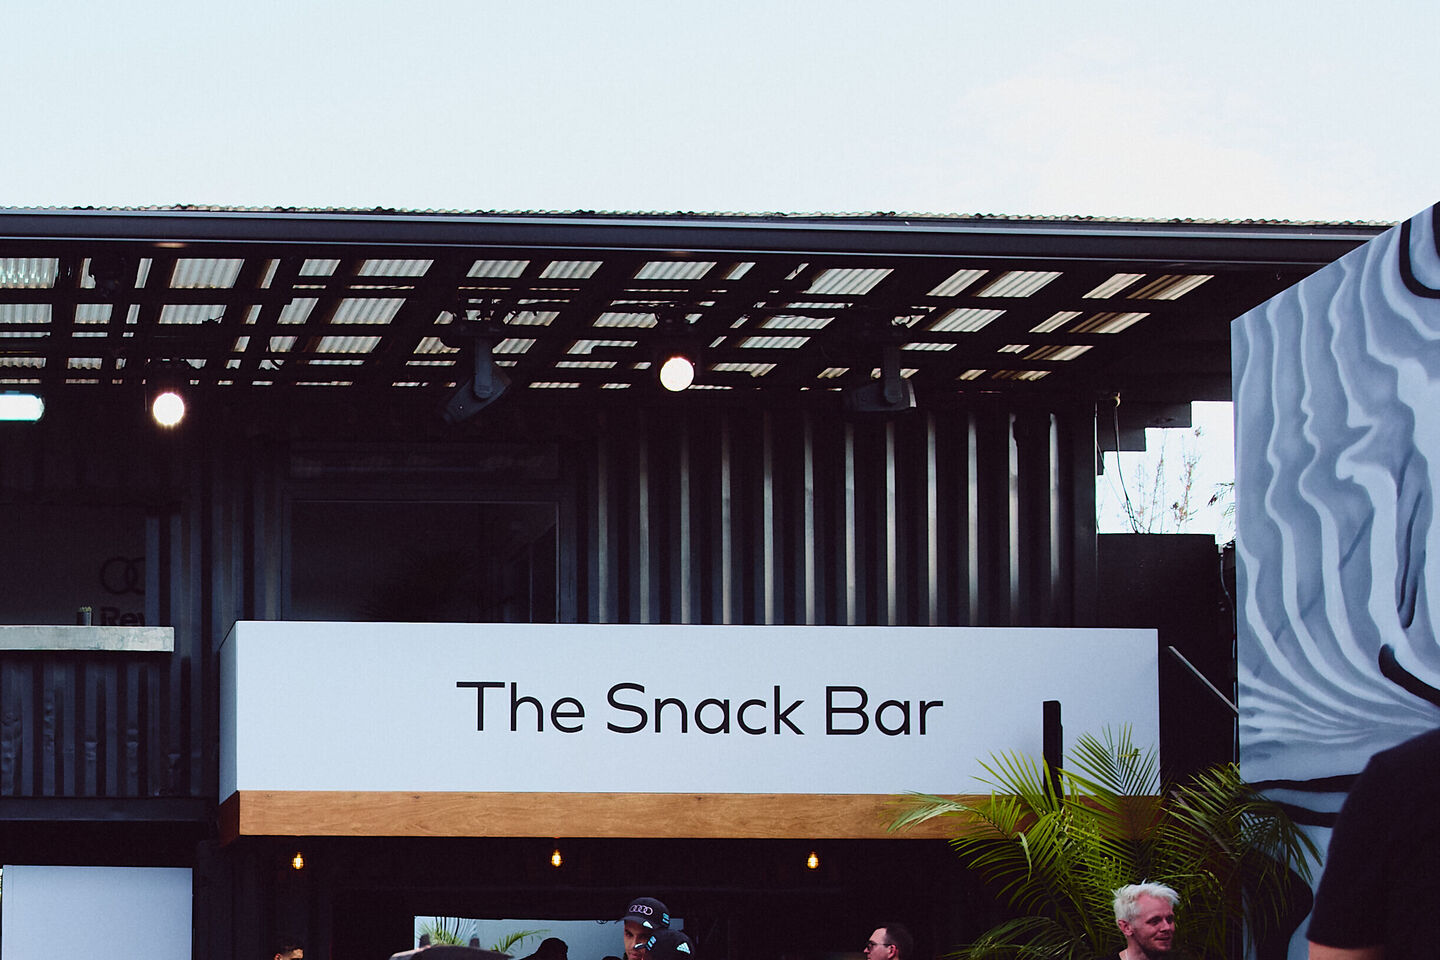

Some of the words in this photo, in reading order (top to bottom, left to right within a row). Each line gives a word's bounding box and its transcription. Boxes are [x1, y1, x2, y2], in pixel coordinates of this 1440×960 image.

[456, 681, 586, 734] The
[606, 682, 805, 736] Snack
[825, 685, 944, 737] Bar
